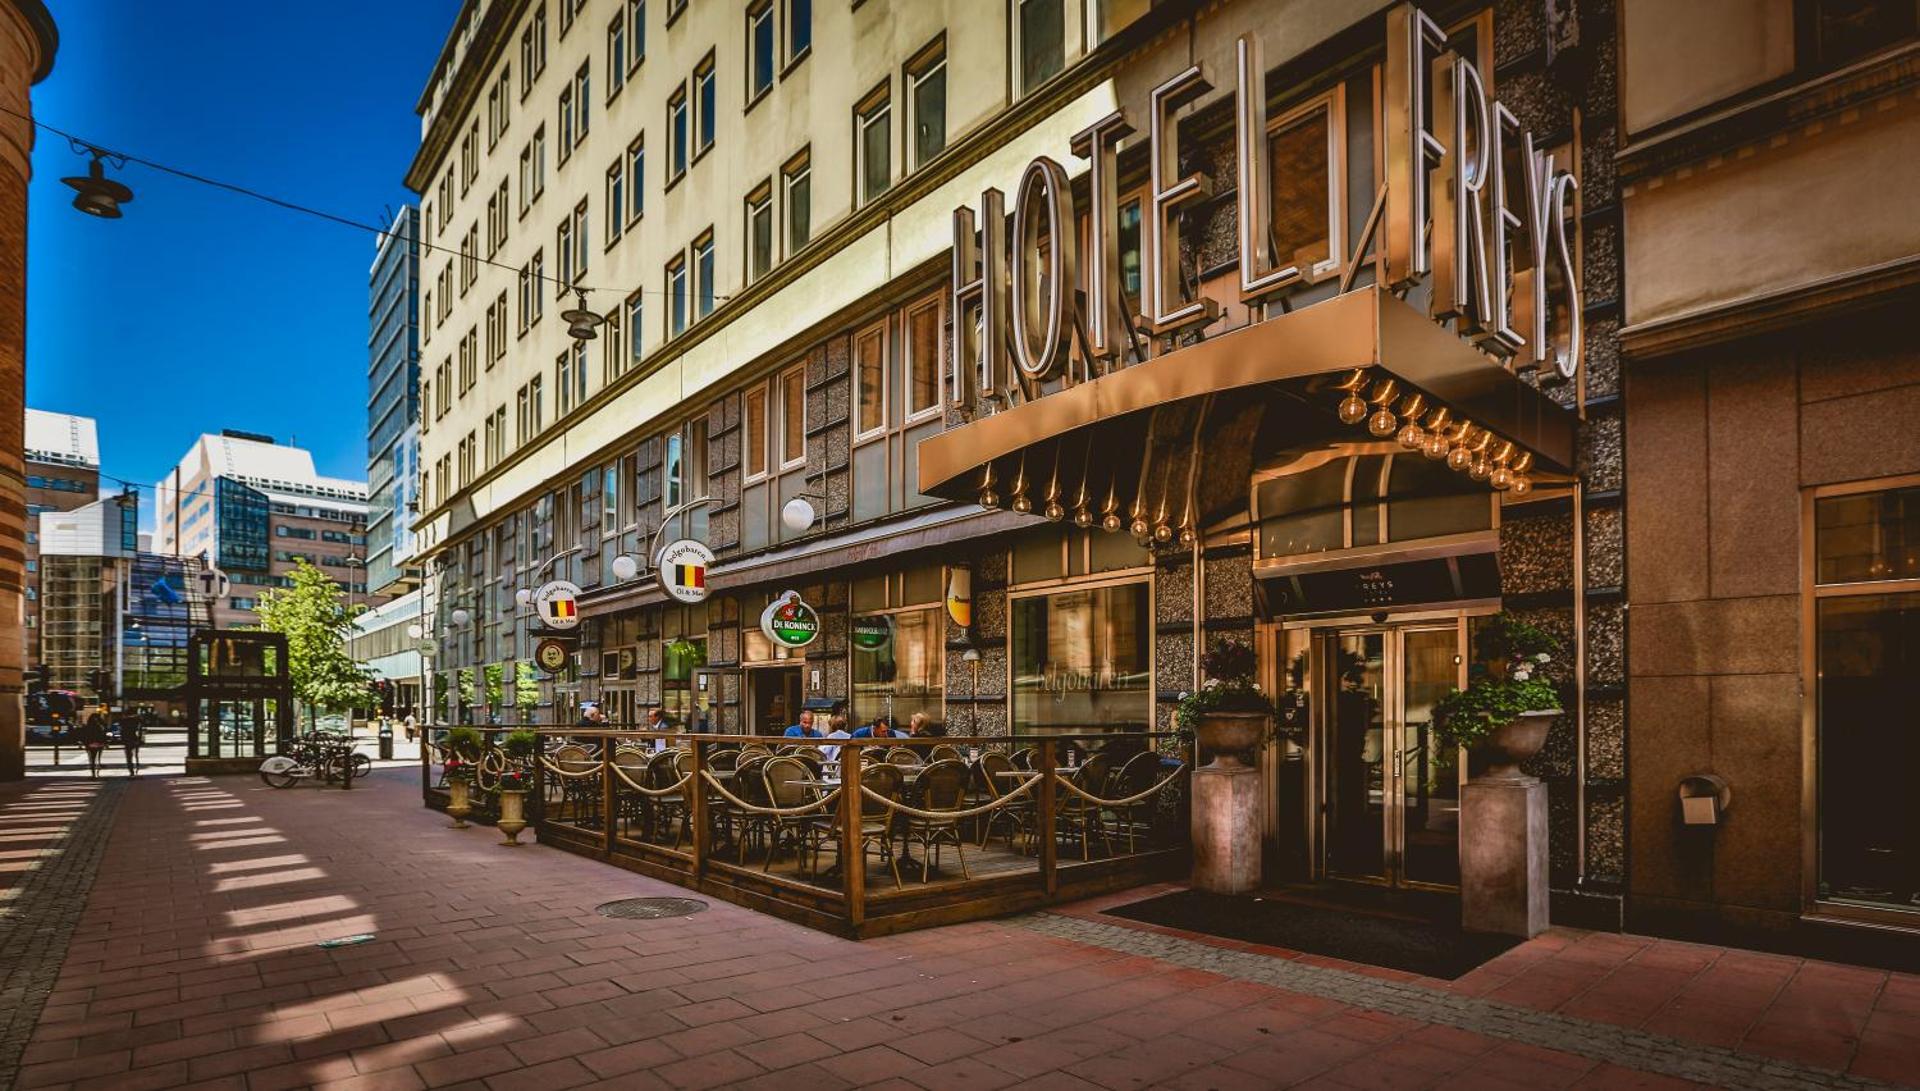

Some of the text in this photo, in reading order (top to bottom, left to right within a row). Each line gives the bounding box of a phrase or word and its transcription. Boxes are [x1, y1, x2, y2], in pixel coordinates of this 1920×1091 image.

[952, 7, 1579, 405] HOTEL FREYS
[773, 620, 817, 631] DE KONINCK
[1035, 660, 1131, 704] belgobaren
